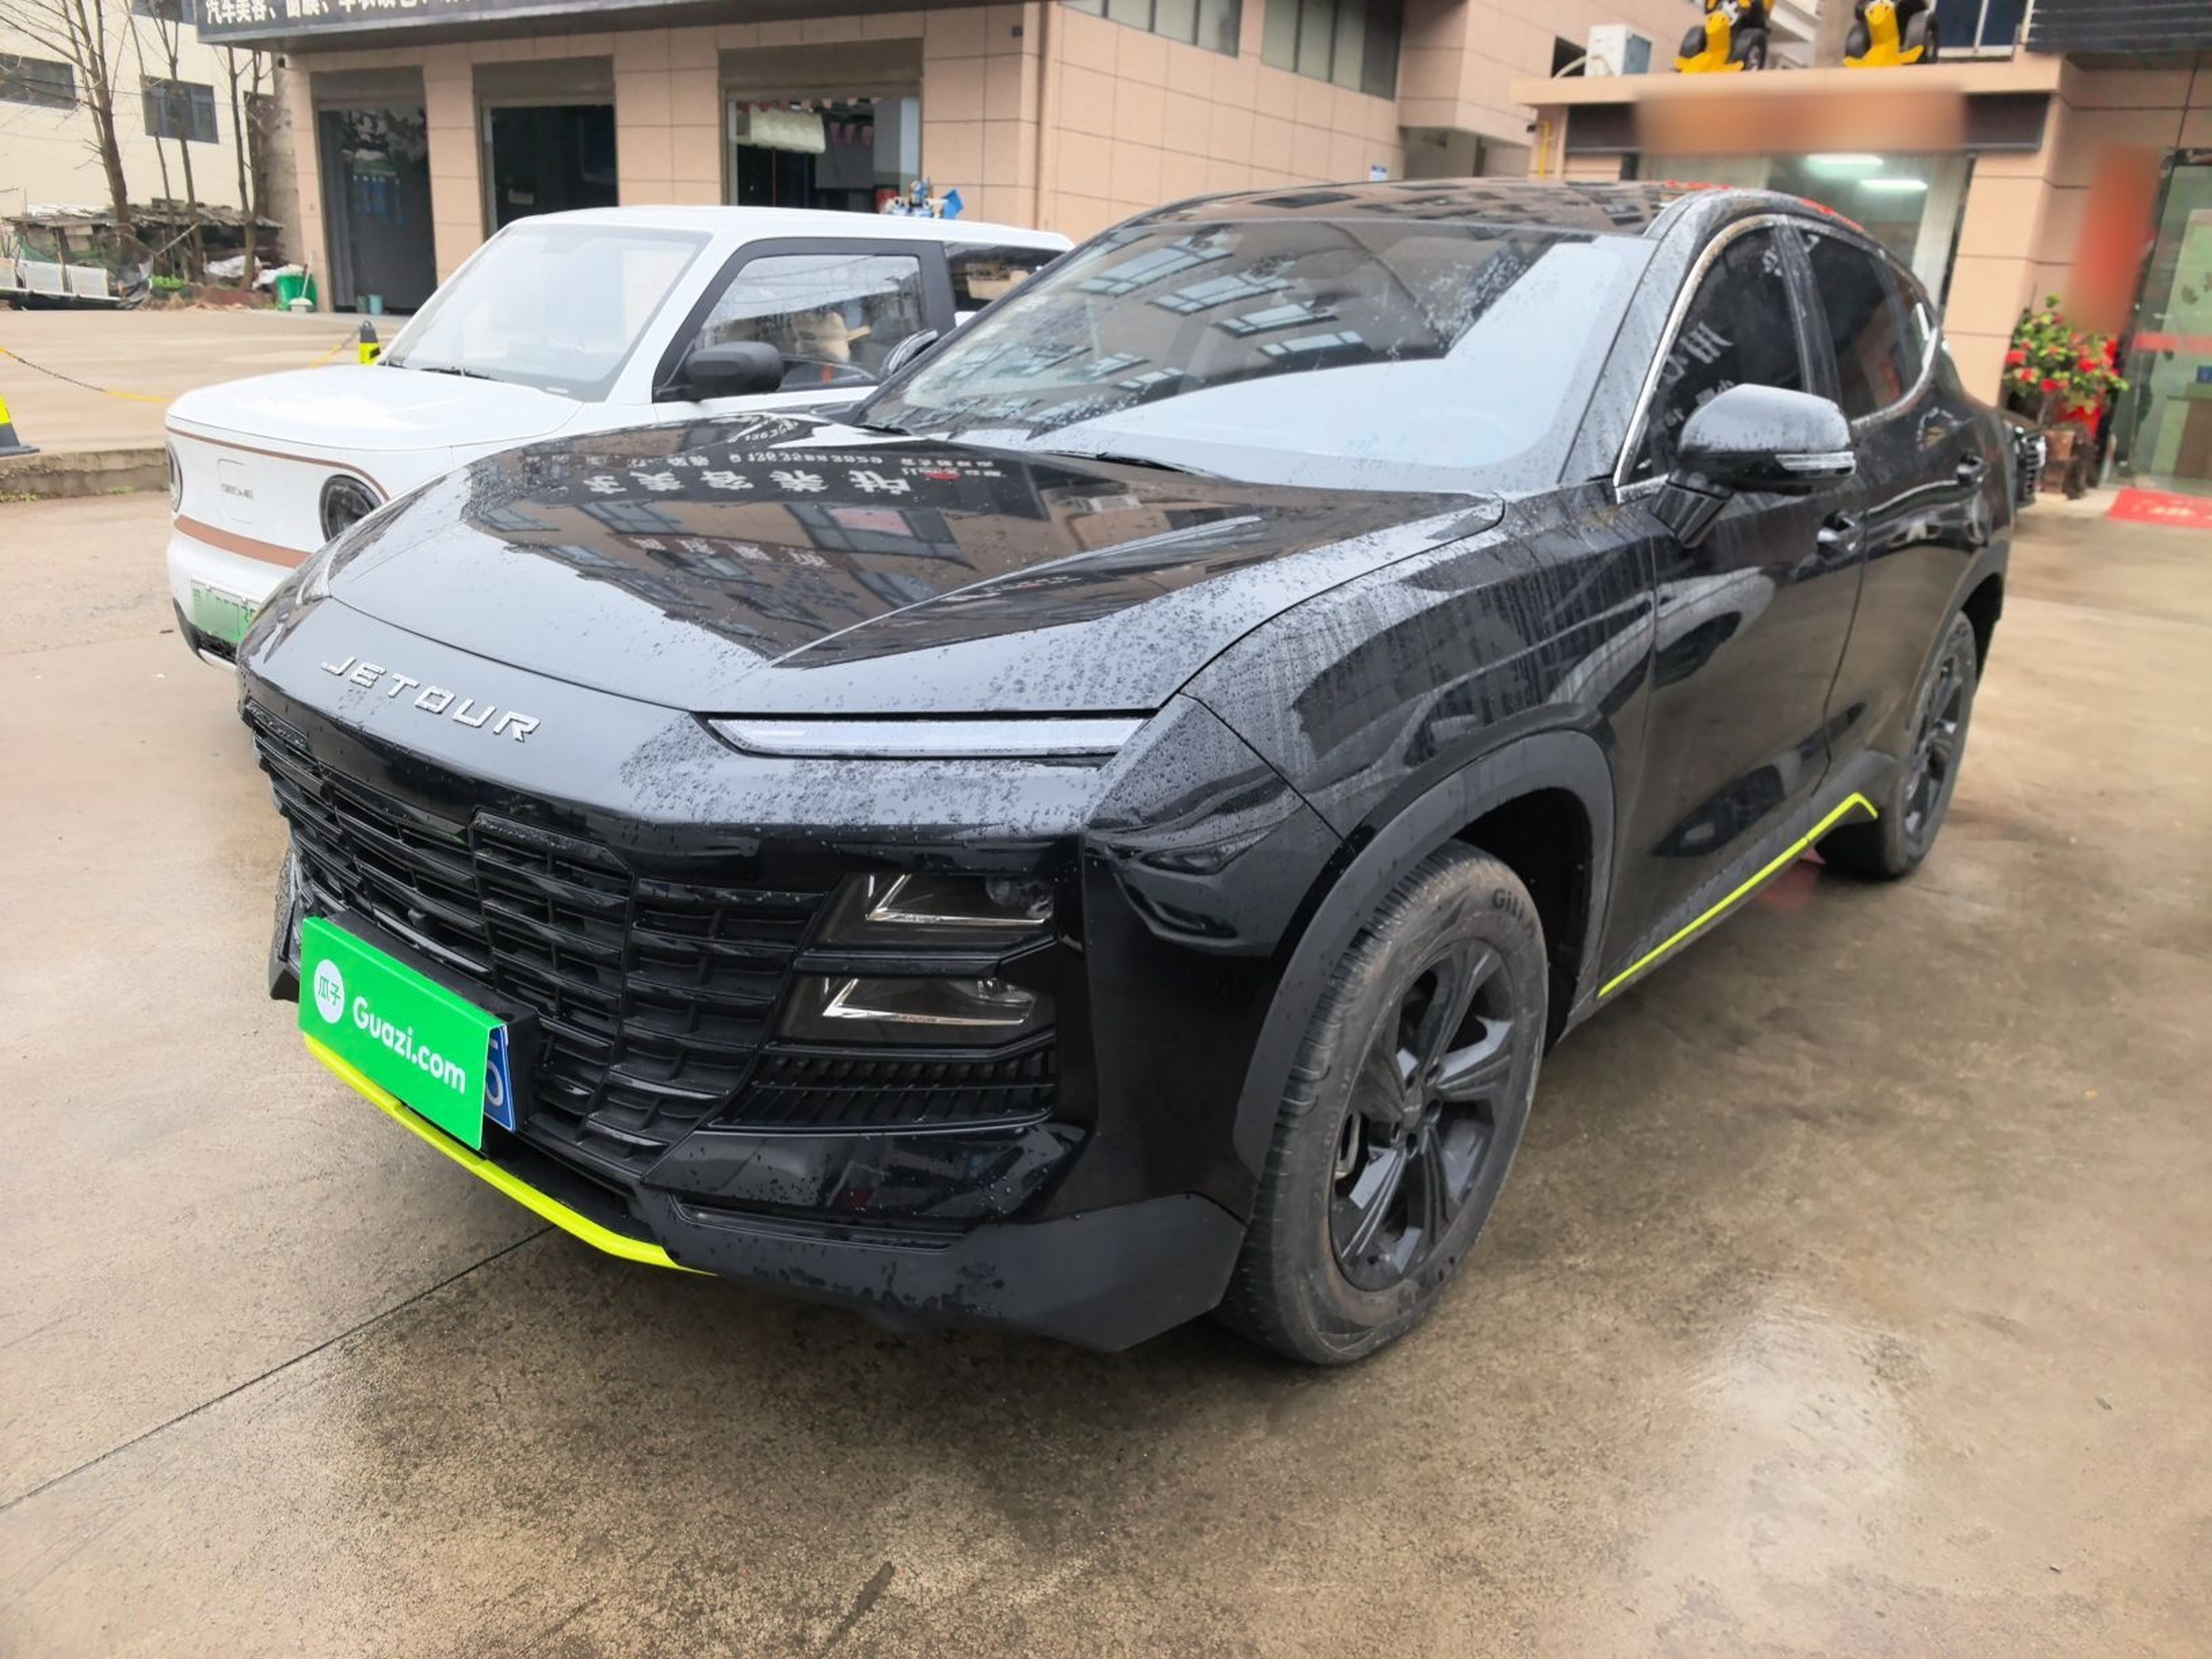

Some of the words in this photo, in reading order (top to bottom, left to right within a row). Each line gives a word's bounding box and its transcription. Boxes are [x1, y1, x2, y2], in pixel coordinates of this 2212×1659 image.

[321, 656, 541, 743] JETOUR
[319, 975, 341, 1006] 瓜子
[353, 996, 465, 1094] Guazi.com
